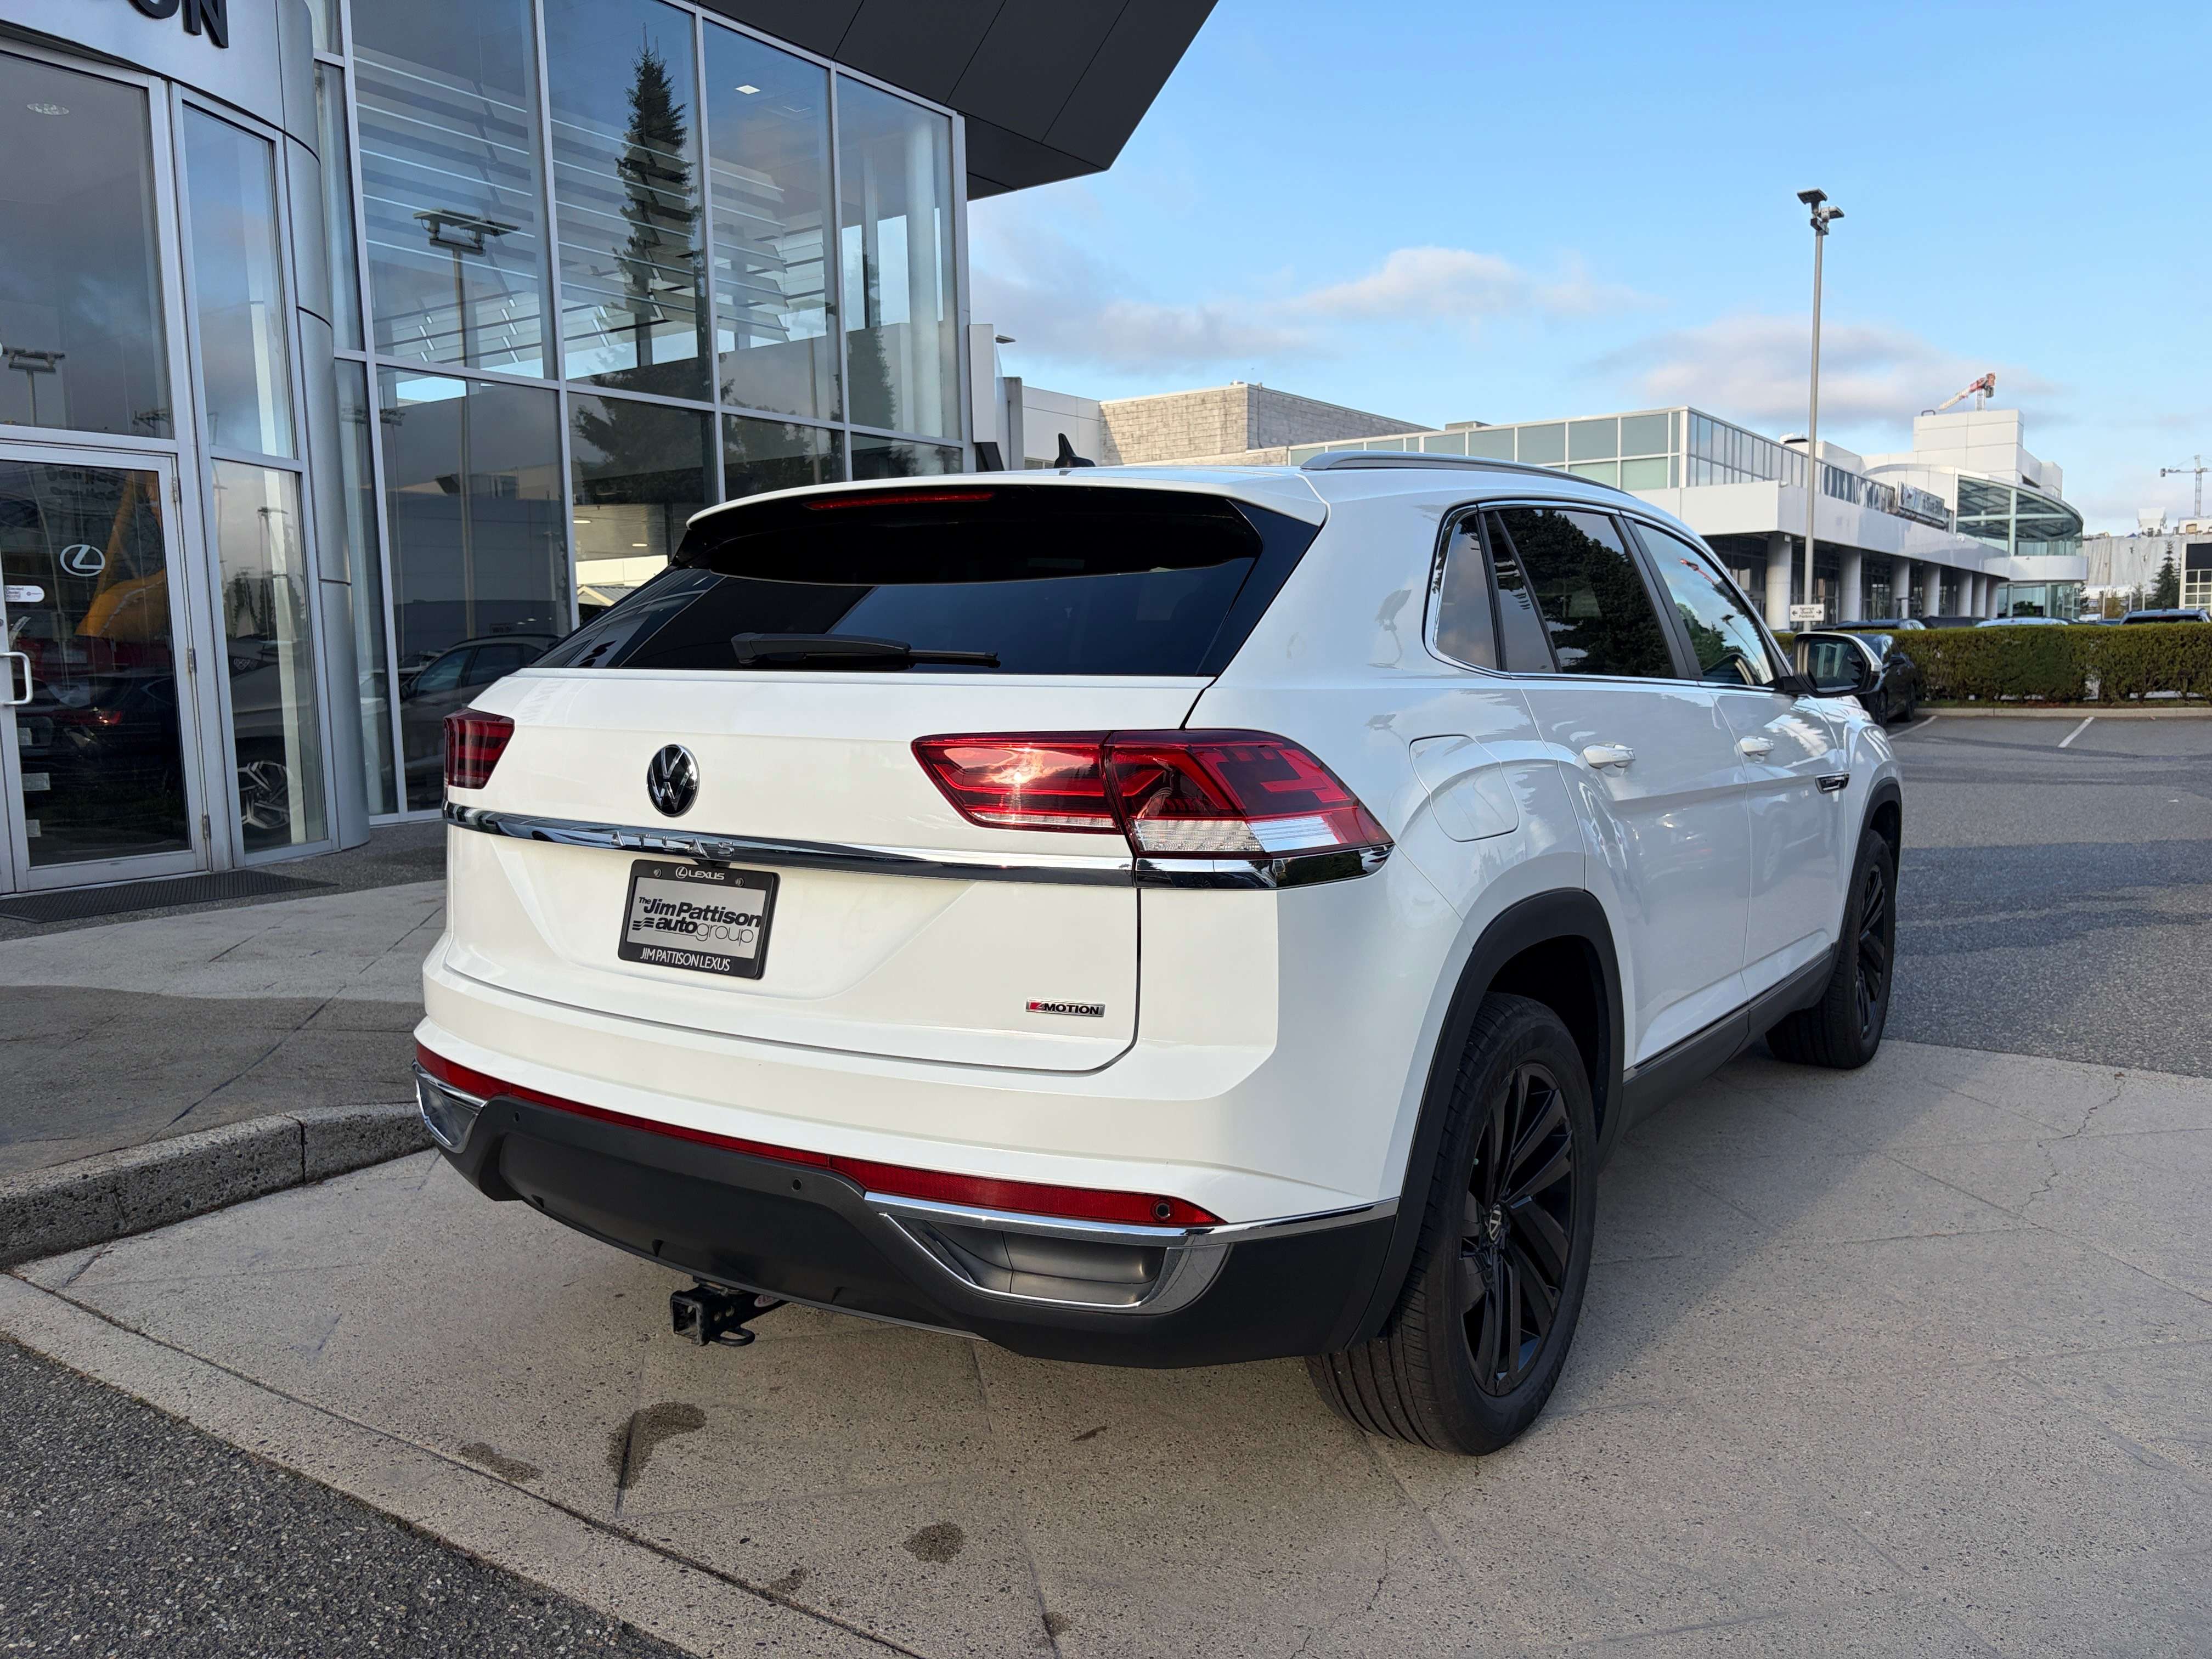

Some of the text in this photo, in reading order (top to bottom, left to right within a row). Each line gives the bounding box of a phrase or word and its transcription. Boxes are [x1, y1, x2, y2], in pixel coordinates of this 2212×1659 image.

[610, 831, 735, 857] ATLAS
[689, 870, 725, 881] LEXUS
[639, 896, 652, 905] The
[640, 947, 731, 972] JIM PATTISON LEXUS
